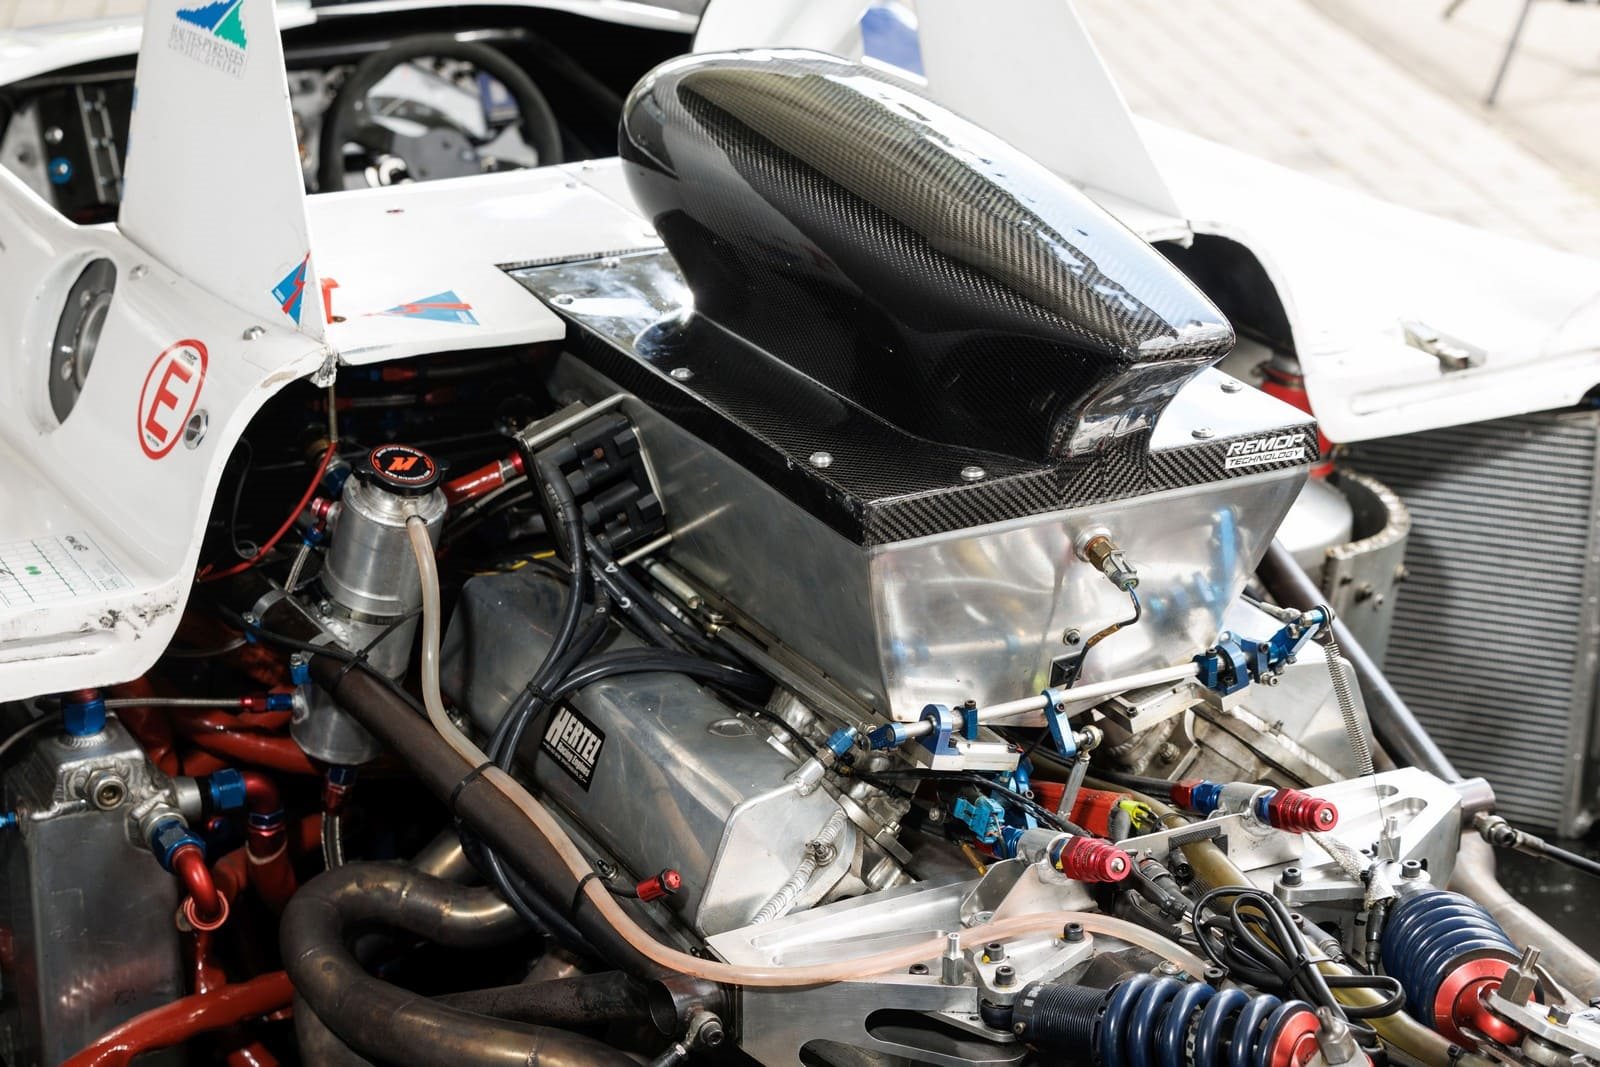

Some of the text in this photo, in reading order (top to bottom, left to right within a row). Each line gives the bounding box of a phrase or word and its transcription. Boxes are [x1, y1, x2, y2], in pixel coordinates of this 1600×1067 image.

[145, 359, 192, 443] E
[1226, 433, 1306, 457] REMOP
[1230, 448, 1302, 466] TECHNOLOGY
[545, 707, 602, 766] HERTEL
